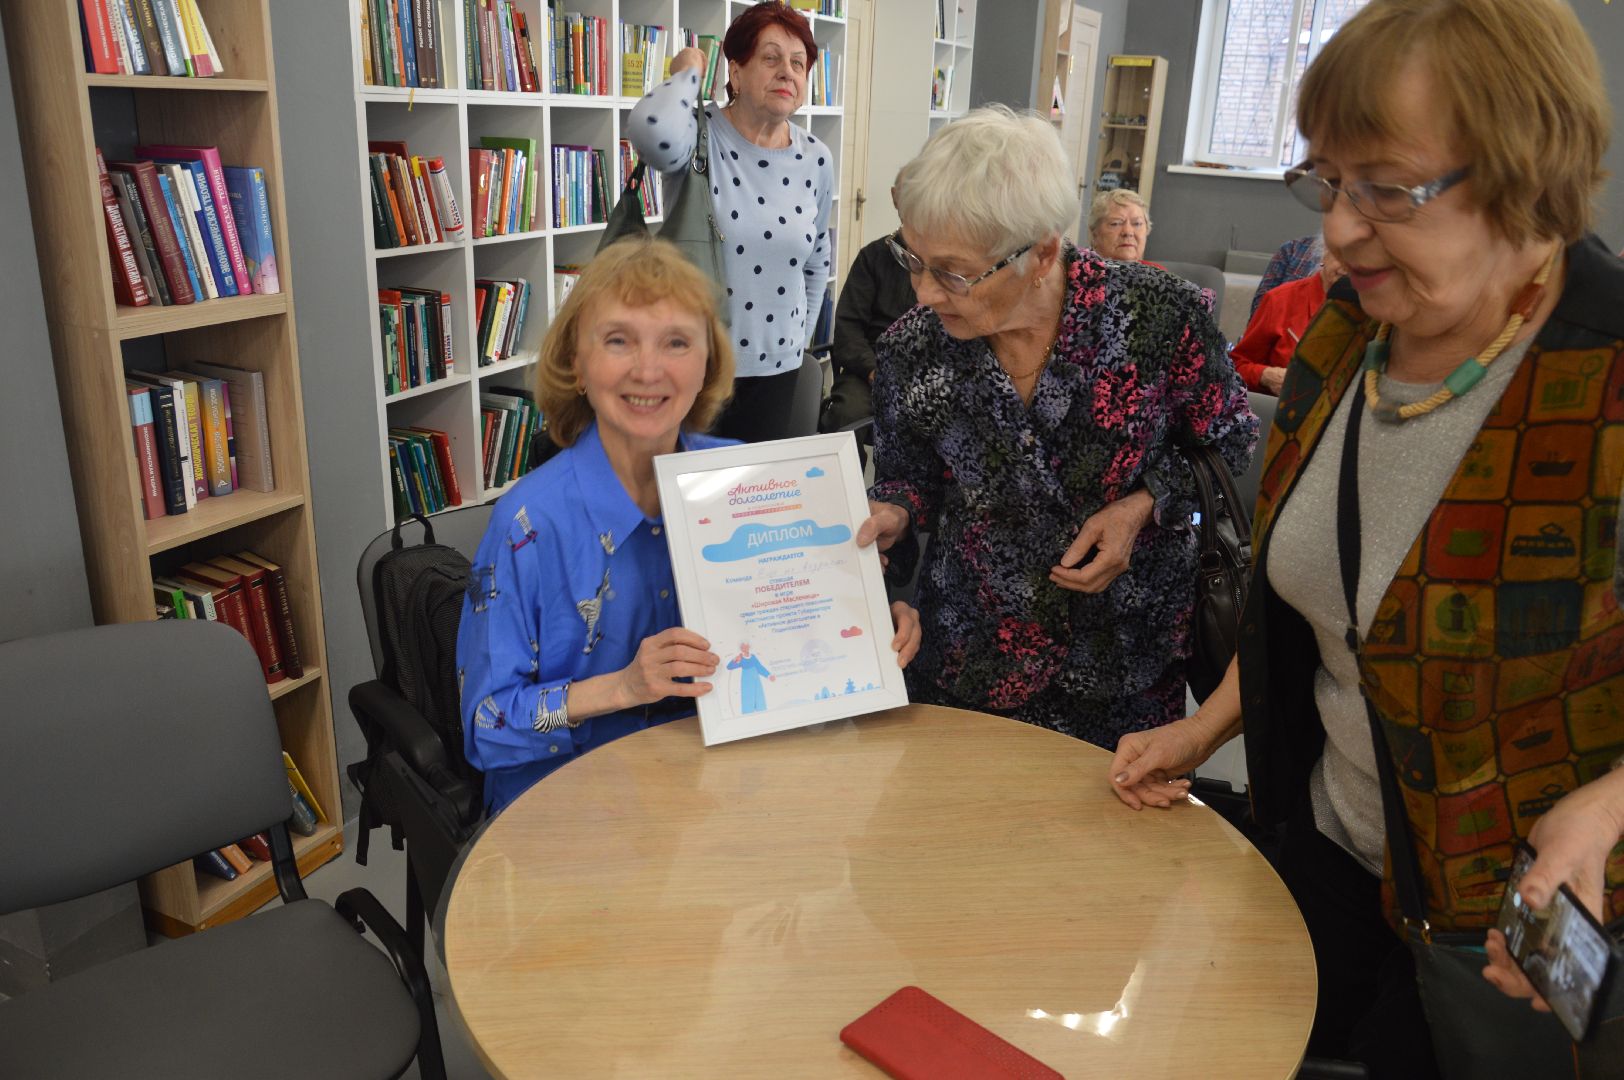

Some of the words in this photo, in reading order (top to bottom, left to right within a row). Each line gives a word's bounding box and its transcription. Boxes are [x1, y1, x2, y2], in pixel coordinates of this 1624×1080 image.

[195, 172, 211, 204] ТЕОРИЯ
[213, 168, 226, 200] ТЕОРИЯ
[105, 203, 131, 250] ДИАЛЕКТИКА
[257, 186, 272, 239] ЭКОНОМИКА
[204, 203, 231, 274] ЭКОНОМИЧЕСКАЯ
[221, 204, 243, 273] ЭКОНОМИЧЕСКАЯ
[189, 421, 204, 482] ЭКОНОМИЧЕСКАЯ
[728, 479, 798, 496] Активное
[729, 489, 801, 506] долголетие
[747, 525, 813, 549] ДИПЛОМ
[758, 551, 804, 564] НАГРАЖДАЕТСЯ
[755, 579, 810, 594] ПОБЕДИТЕЛЕМ
